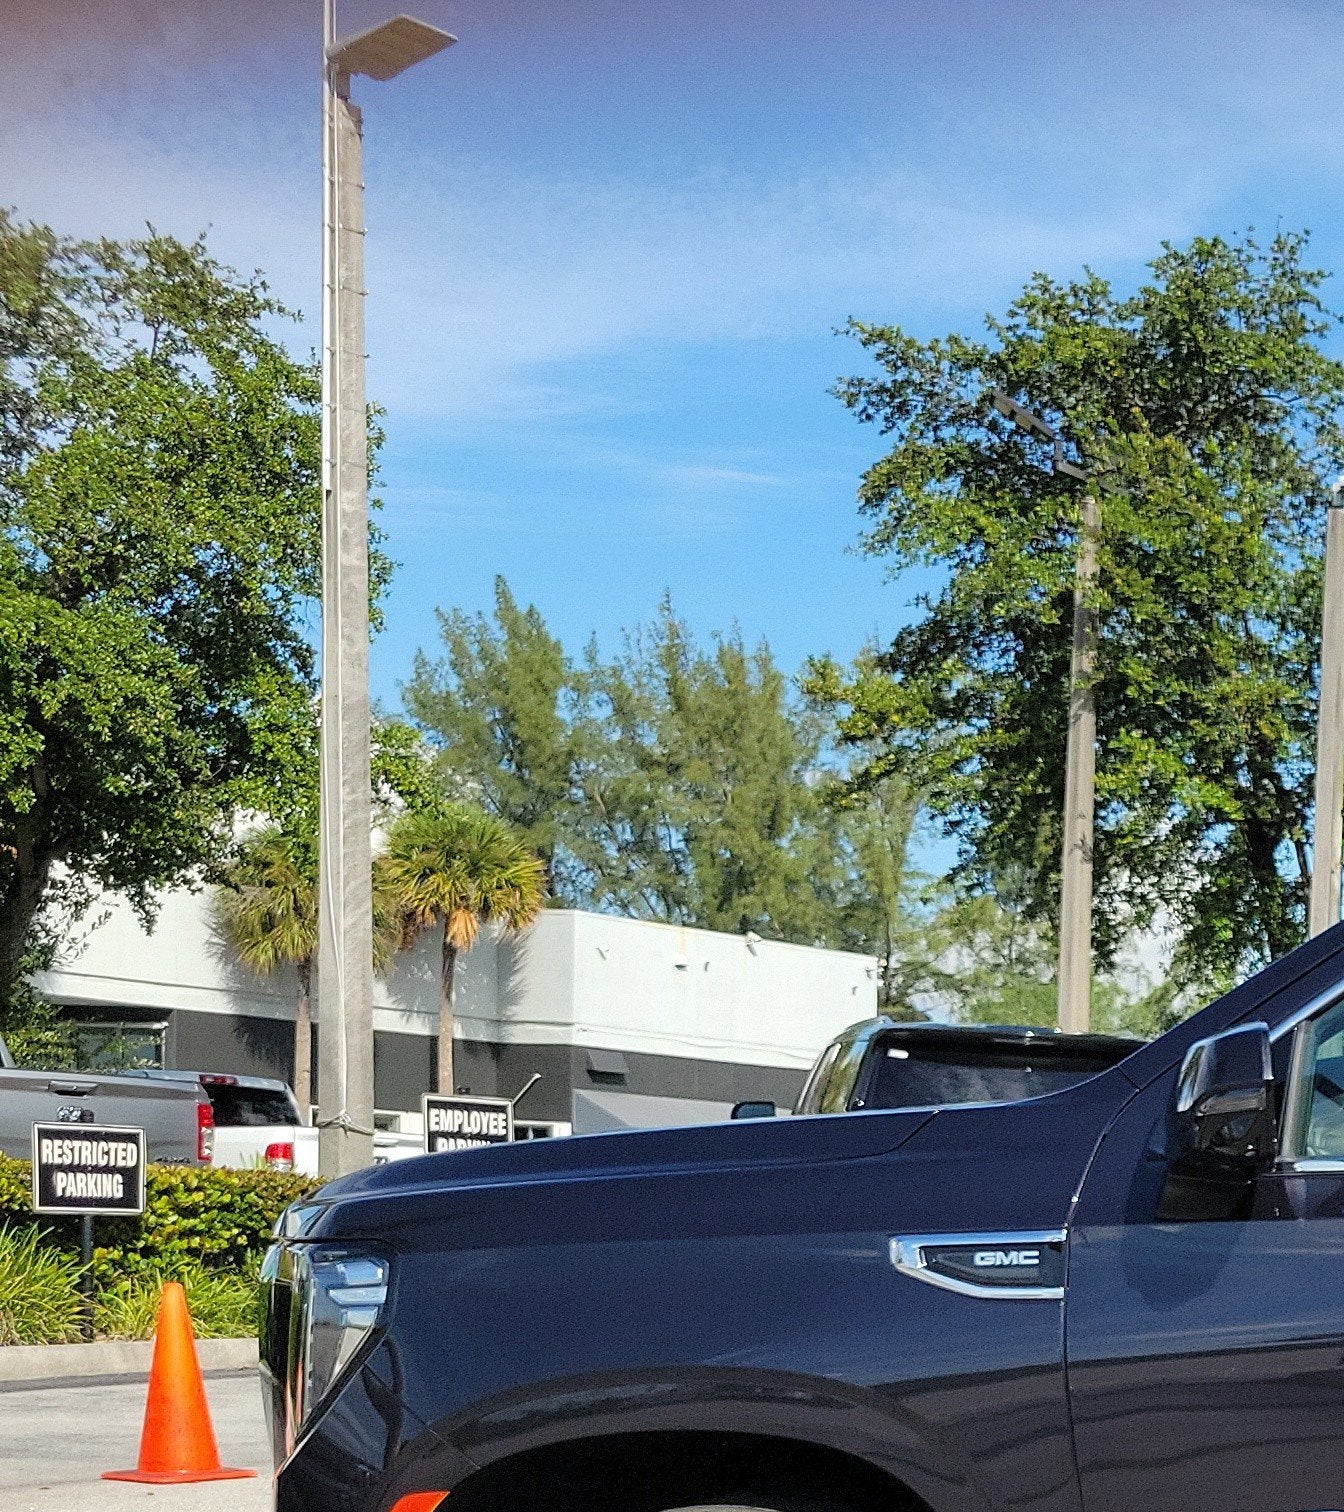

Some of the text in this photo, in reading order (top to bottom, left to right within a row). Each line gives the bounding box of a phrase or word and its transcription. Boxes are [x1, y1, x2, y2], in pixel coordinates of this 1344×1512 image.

[429, 1108, 507, 1136] EMPLOYEE
[41, 1138, 138, 1167] RESTRICTED
[56, 1171, 124, 1199] PARKING
[973, 1250, 1040, 1266] GMC
